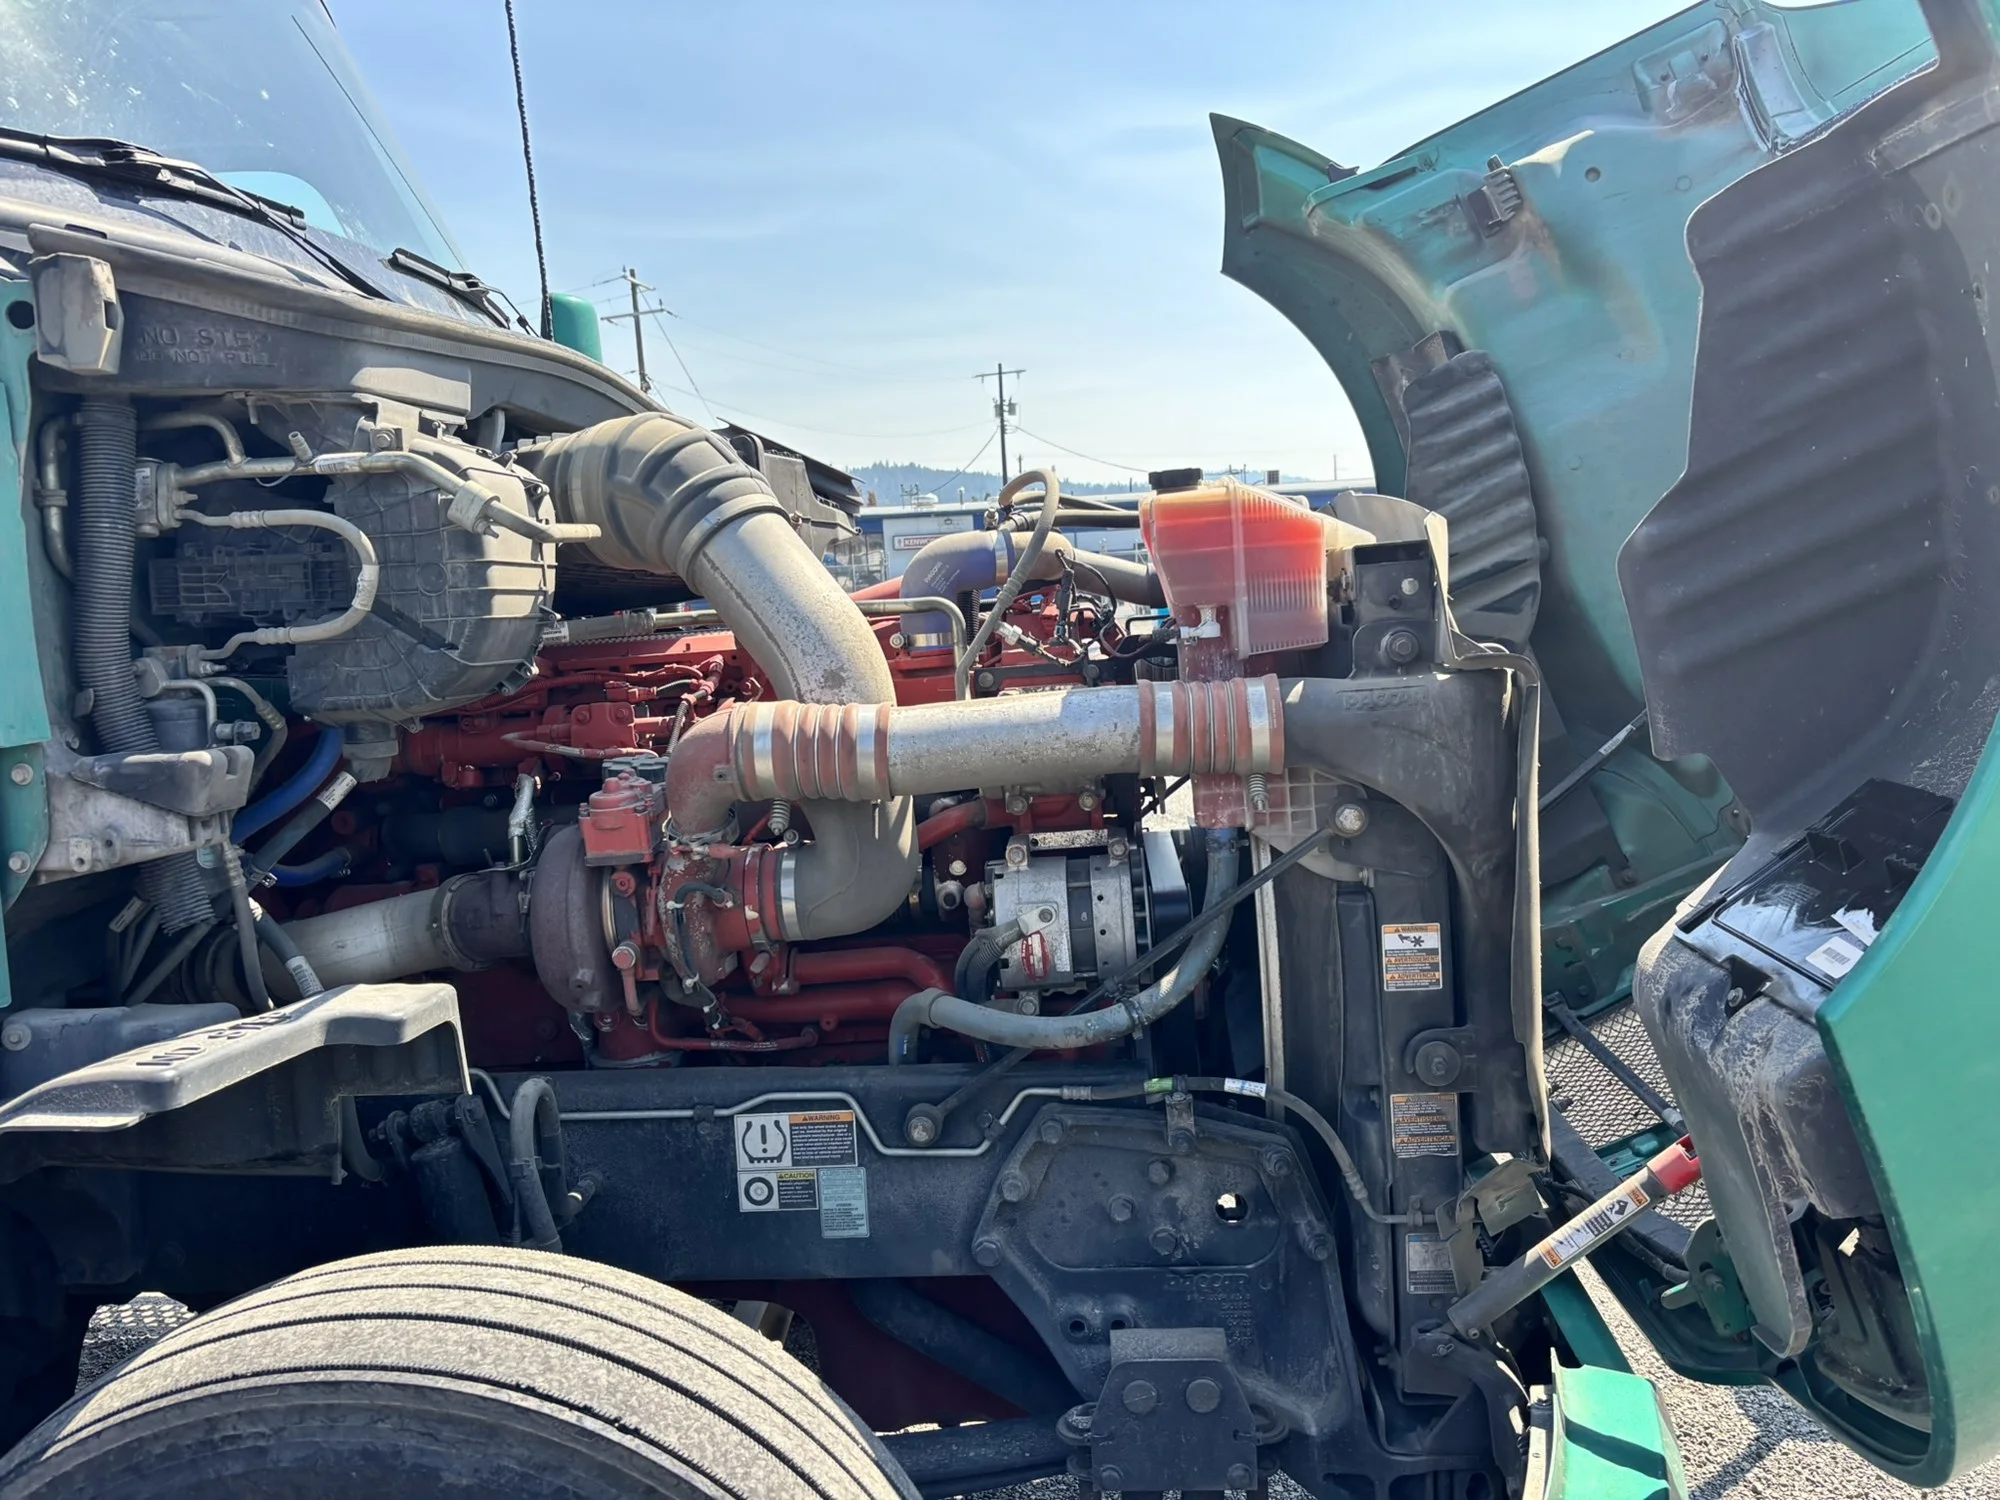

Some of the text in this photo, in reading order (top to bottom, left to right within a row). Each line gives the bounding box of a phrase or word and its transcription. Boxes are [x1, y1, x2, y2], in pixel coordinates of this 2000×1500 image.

[140, 325, 179, 346] NO
[173, 350, 211, 363] NOT
[223, 351, 278, 367] PULL
[136, 1047, 206, 1066] NO
[808, 1113, 841, 1121] WARNING
[783, 1171, 815, 1179] CAUTION
